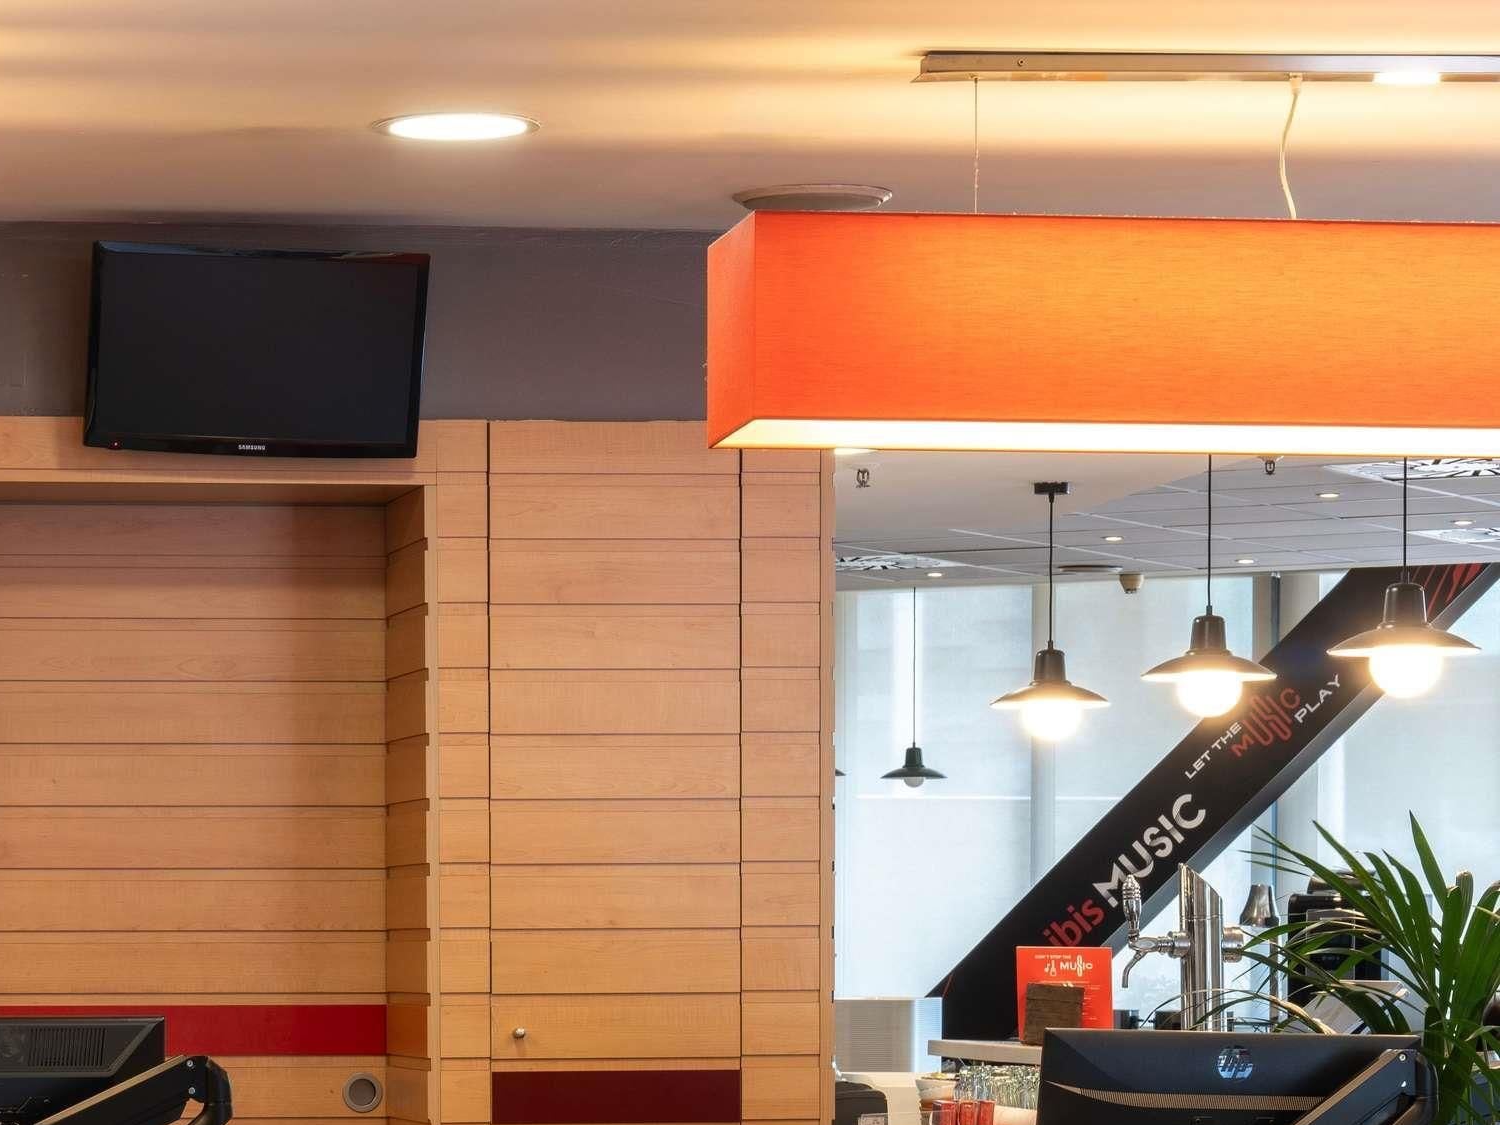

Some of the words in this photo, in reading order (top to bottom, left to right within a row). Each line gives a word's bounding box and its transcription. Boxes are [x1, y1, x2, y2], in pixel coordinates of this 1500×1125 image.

[1230, 688, 1300, 757] MUSIC
[1294, 674, 1341, 724] PLAY
[1185, 750, 1211, 780] LET
[1211, 721, 1243, 751] THE
[1043, 899, 1105, 947] ibis
[1092, 793, 1206, 908] MUSIC
[1060, 954, 1093, 977] MUSIC
